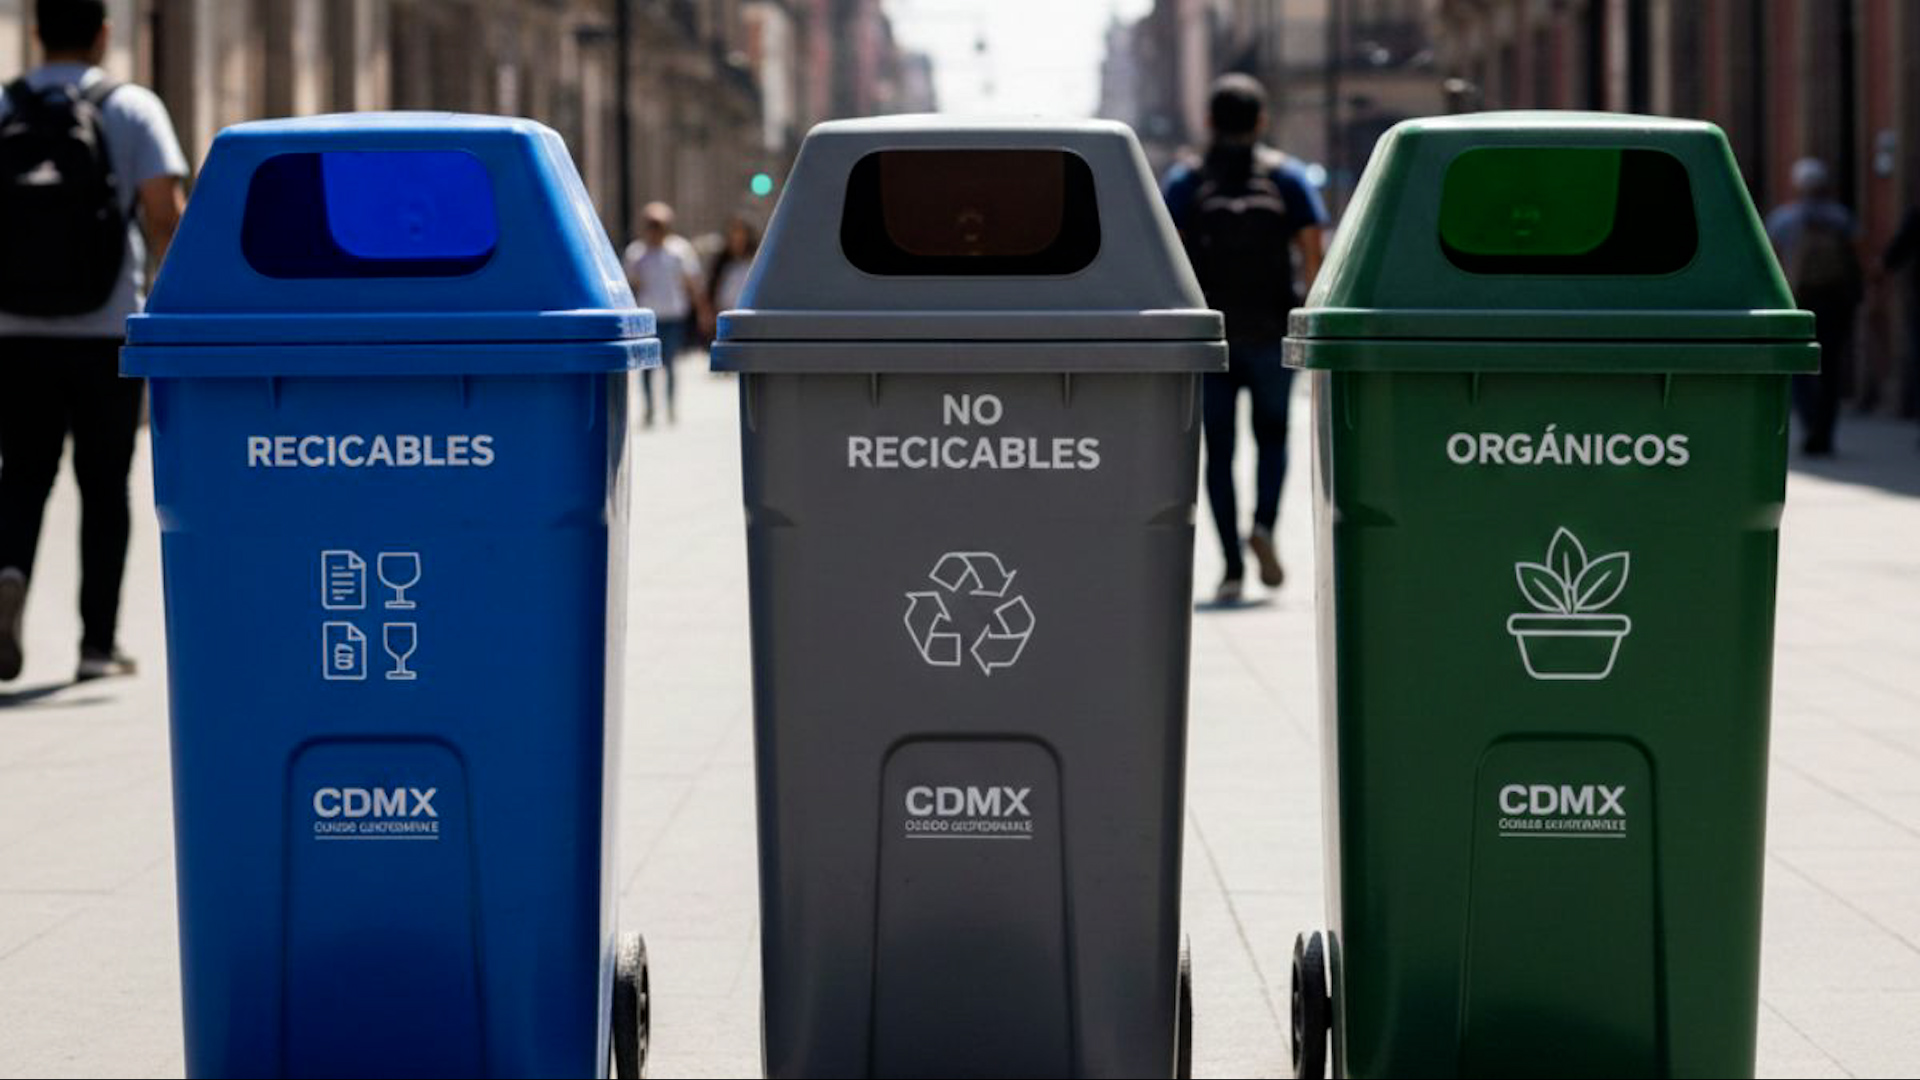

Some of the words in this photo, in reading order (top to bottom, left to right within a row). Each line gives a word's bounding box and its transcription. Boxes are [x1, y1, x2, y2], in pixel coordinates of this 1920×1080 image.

[943, 393, 1003, 426] NO
[248, 434, 495, 468] RECICABLES
[848, 435, 1101, 470] RECICABLES
[1446, 423, 1690, 467] ORGÁNICOS
[313, 787, 438, 818] CDMX
[905, 786, 1031, 817] CDMX
[1499, 784, 1626, 816] CDMX
